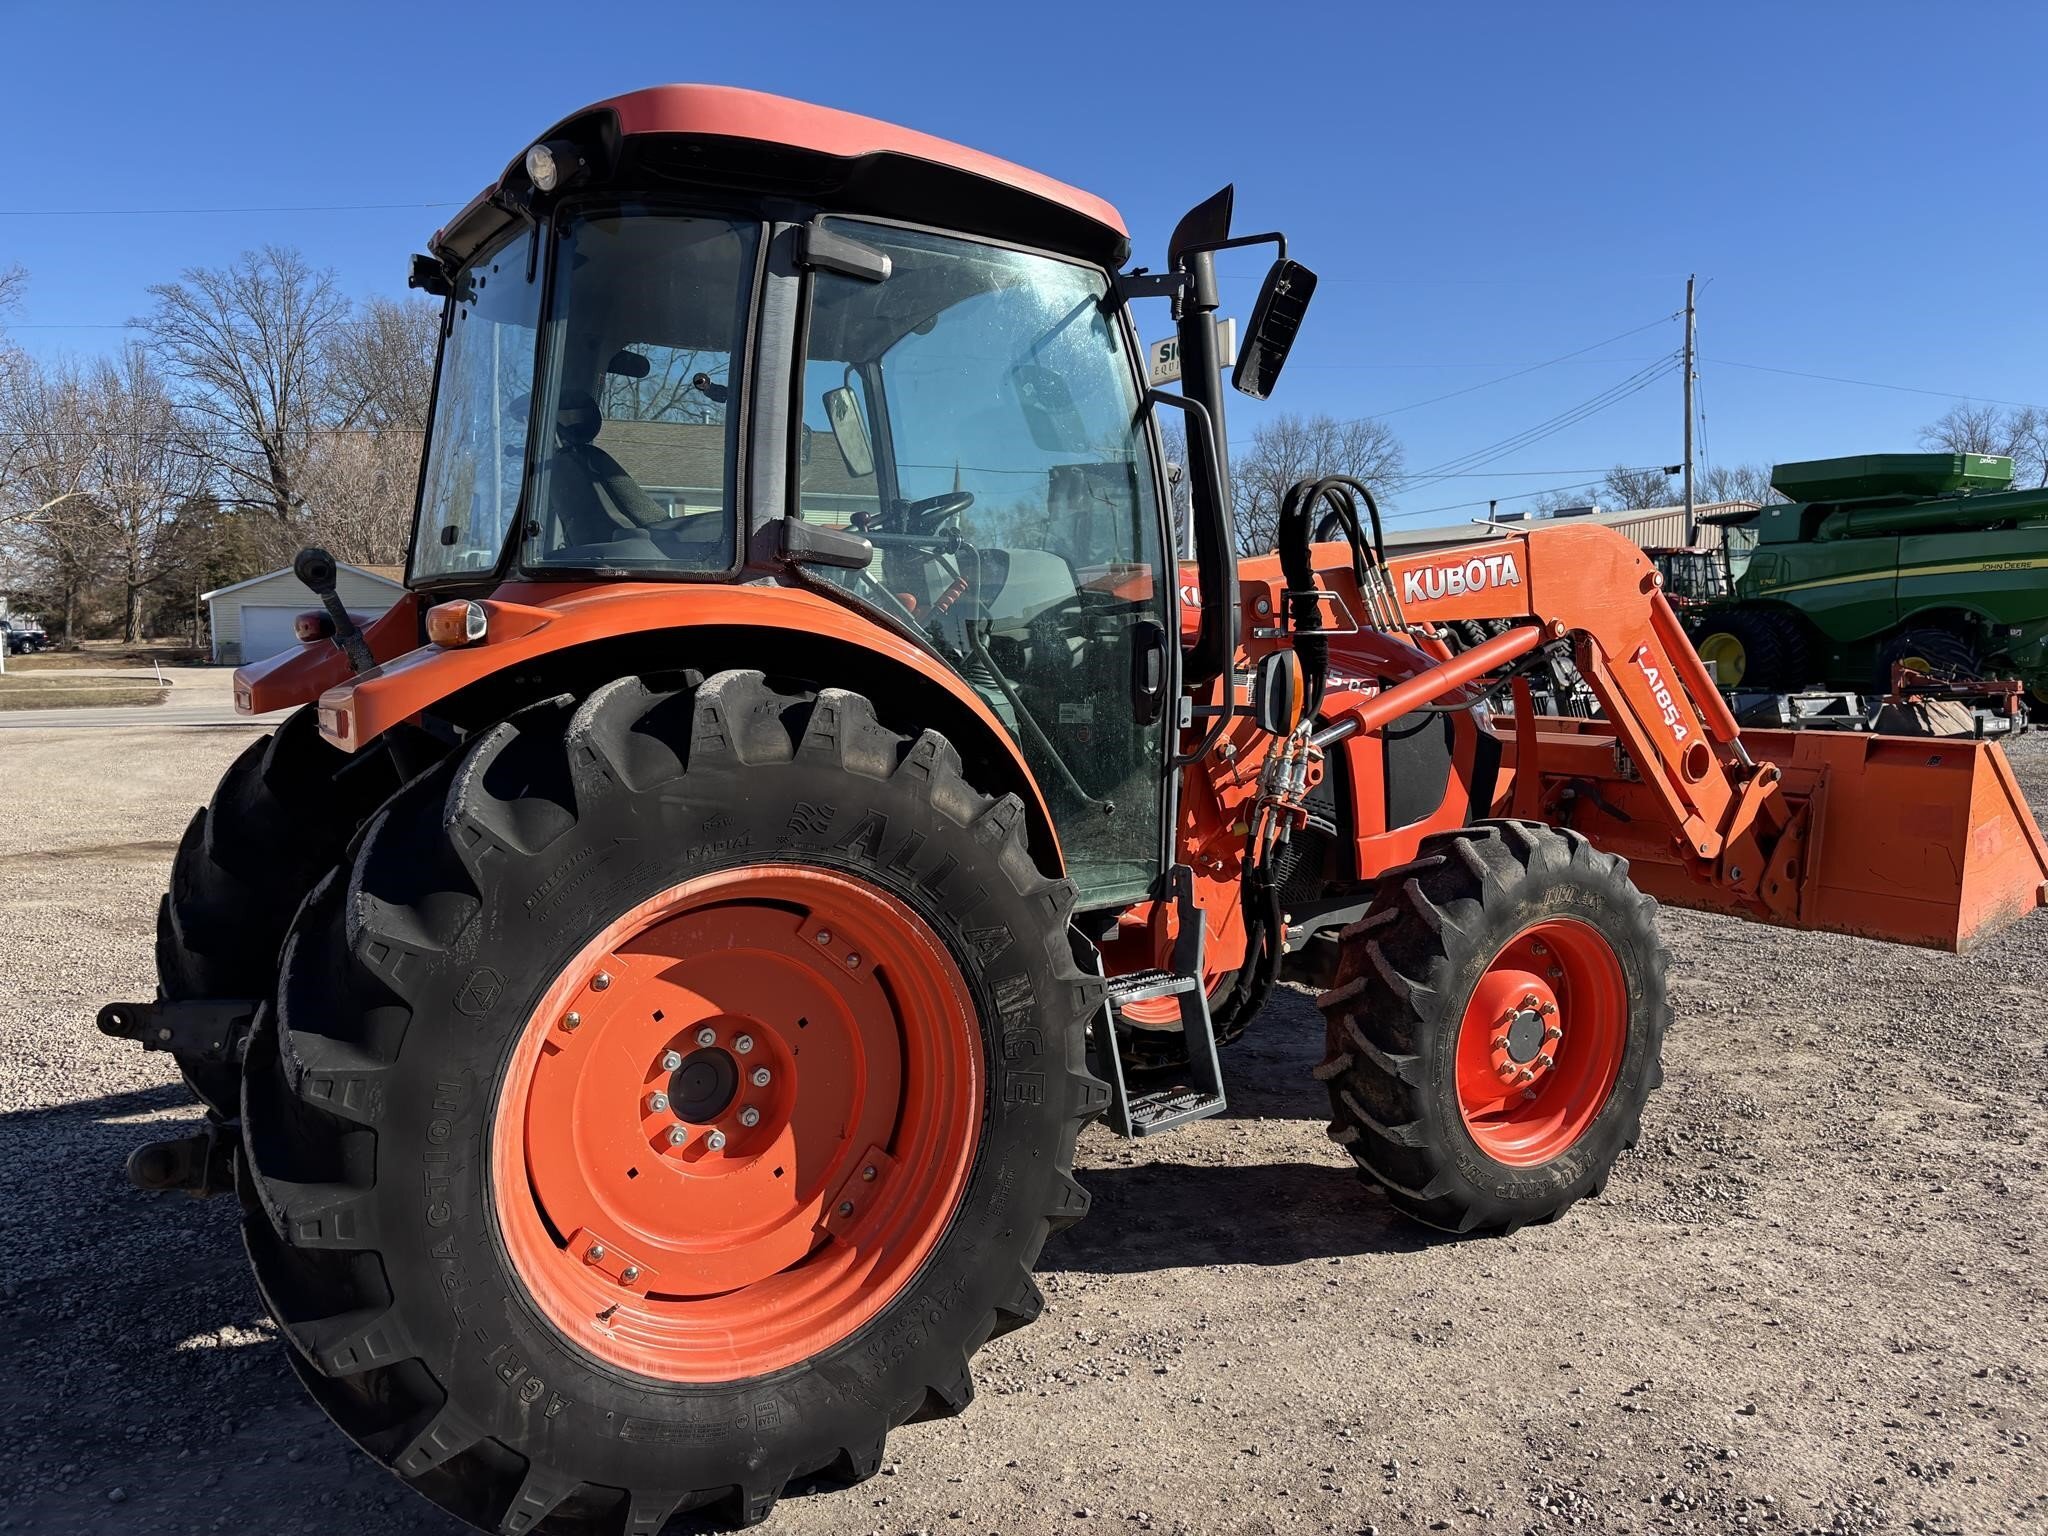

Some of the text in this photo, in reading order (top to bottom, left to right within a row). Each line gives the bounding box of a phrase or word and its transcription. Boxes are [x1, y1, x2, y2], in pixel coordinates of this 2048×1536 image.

[1155, 361, 1179, 375] EQUI
[1160, 343, 1180, 363] SI
[1403, 553, 1521, 604] KUBOTA
[1980, 561, 2033, 571] JOHN DEERE
[1637, 646, 1688, 741] LA1854
[833, 806, 1047, 1105] ALLIANCE
